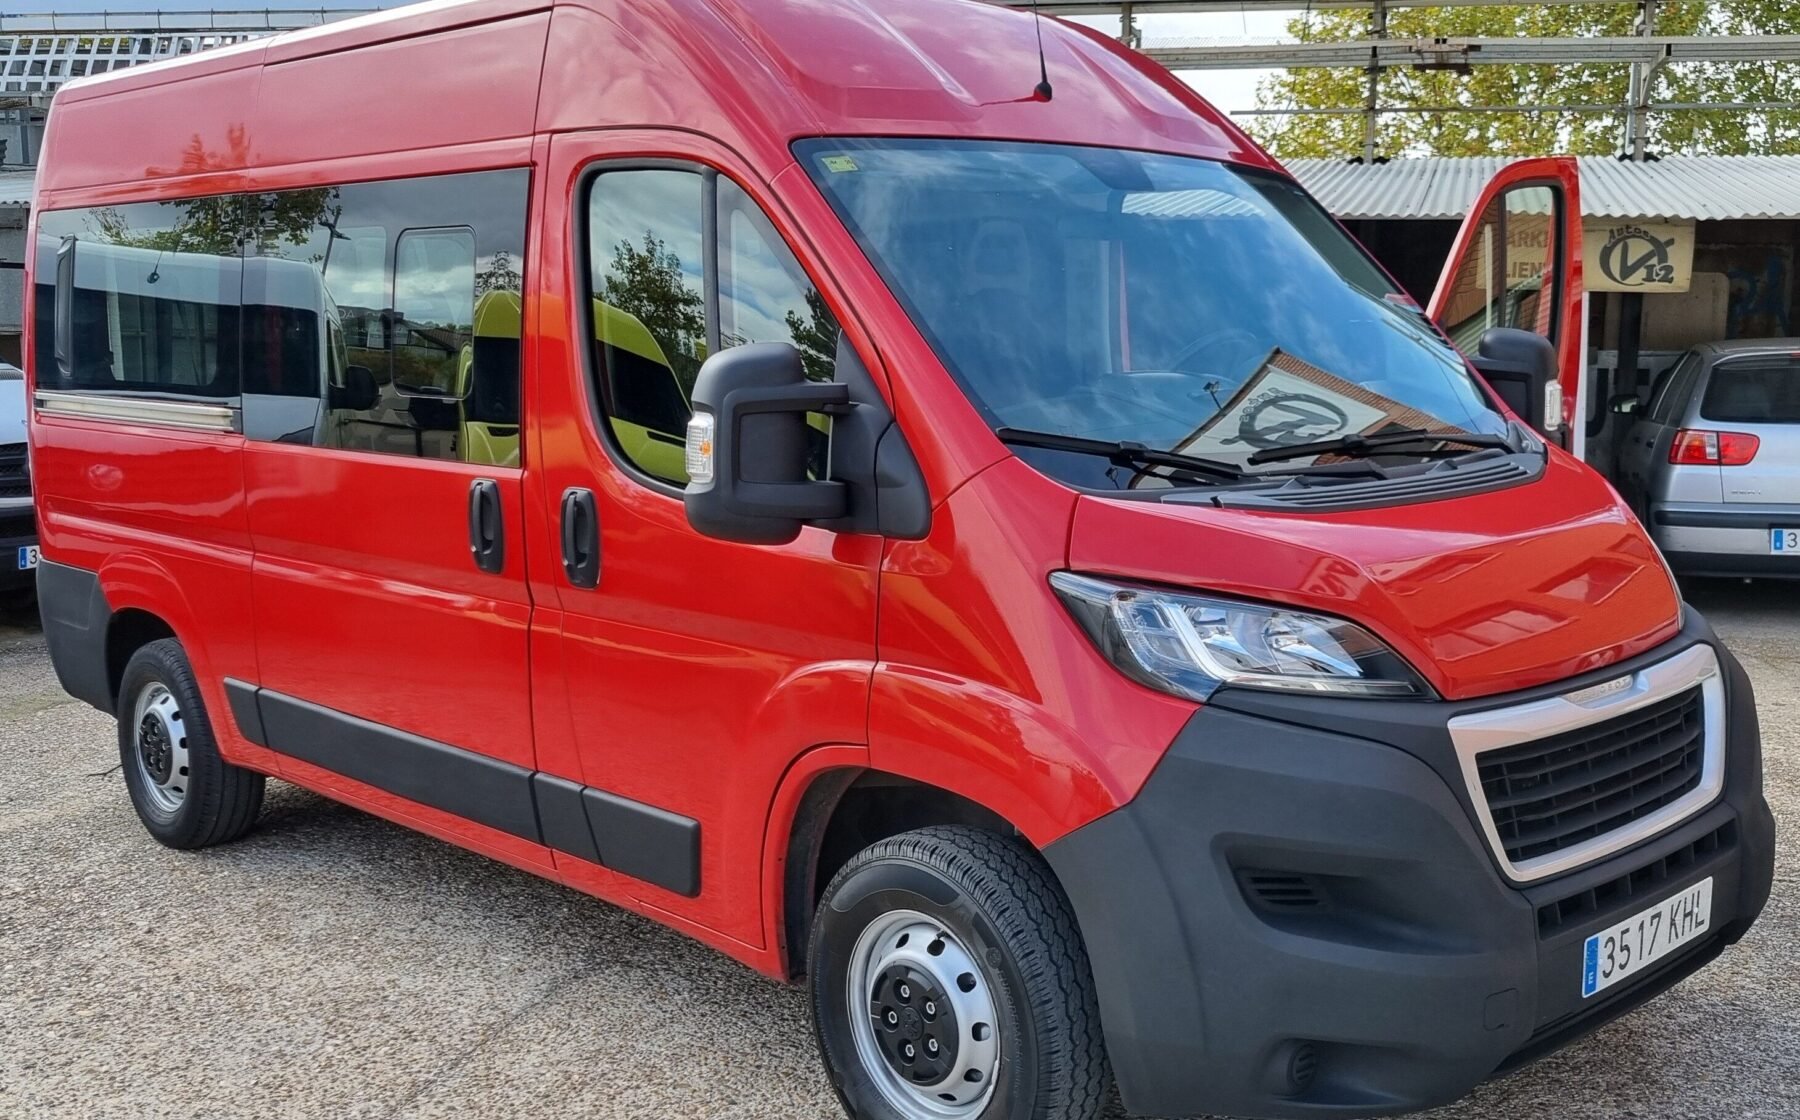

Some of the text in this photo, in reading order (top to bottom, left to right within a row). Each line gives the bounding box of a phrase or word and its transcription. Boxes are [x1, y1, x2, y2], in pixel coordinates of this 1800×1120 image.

[1607, 224, 1650, 247] Autos
[1602, 890, 1705, 979] 3517 KHL
